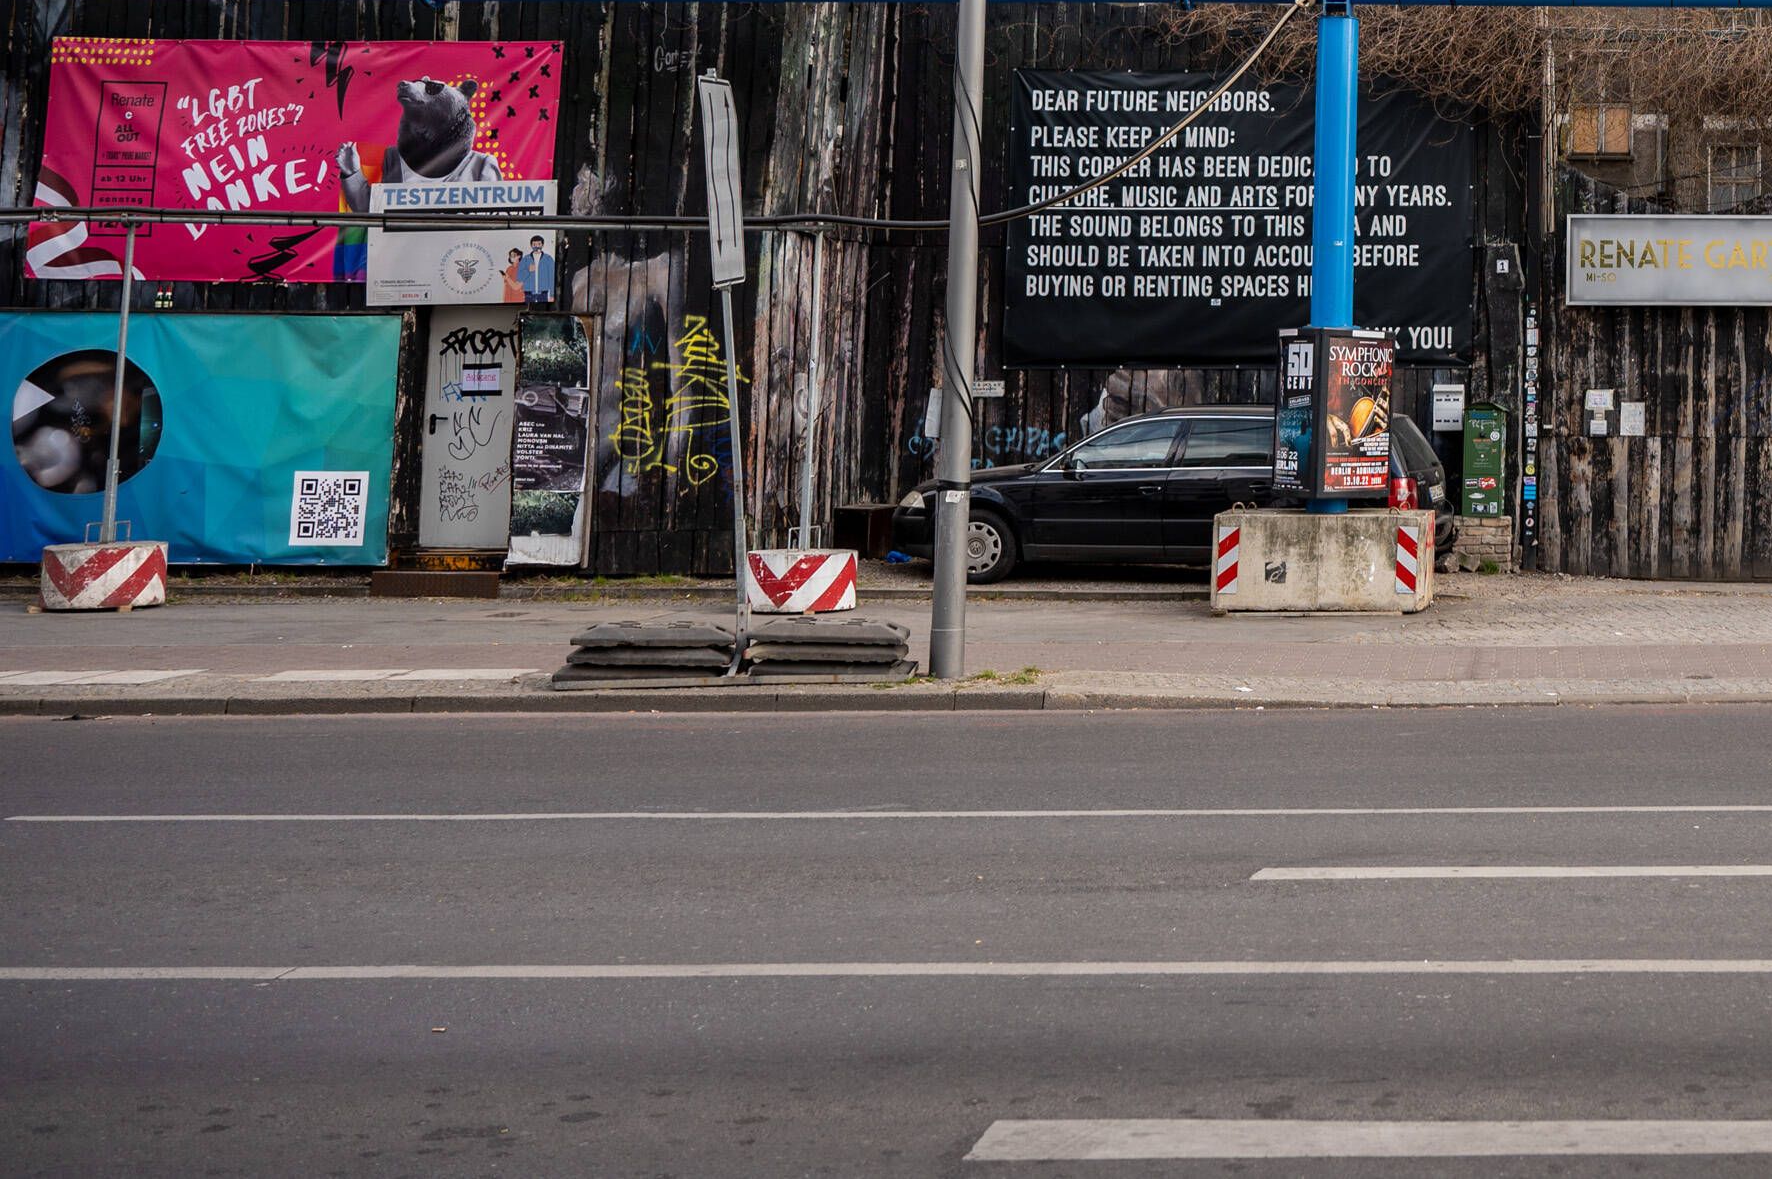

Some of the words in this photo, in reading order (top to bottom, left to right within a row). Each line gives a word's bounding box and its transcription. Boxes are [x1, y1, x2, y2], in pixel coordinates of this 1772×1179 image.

[111, 92, 155, 107] Renate
[1032, 90, 1079, 112] DEAR
[1086, 90, 1158, 112] FUTURE
[114, 123, 134, 134] ALL
[117, 132, 141, 143] OUT
[180, 118, 233, 160] FREE
[1030, 126, 1099, 148] PLEASE
[1106, 126, 1152, 148] KEEP
[1160, 126, 1178, 148] IN
[1185, 126, 1236, 148] MIND:
[182, 134, 269, 201] NEIN
[1030, 155, 1071, 178] THIS
[1078, 155, 1151, 178] CORNER
[1158, 155, 1196, 178] HAS
[1203, 155, 1250, 178] BEEN
[1367, 155, 1391, 178] TO
[115, 175, 126, 183] 12
[129, 175, 146, 183] Uhr
[99, 196, 143, 205] sonntag
[383, 185, 545, 206] TESTZENTRUM
[1122, 185, 1177, 208] MUSIC
[1185, 185, 1222, 208] AND
[1230, 185, 1278, 208] ARTS
[1386, 185, 1452, 208] YEARS.
[1028, 215, 1062, 237] THE
[1069, 215, 1132, 237] SOUND
[1140, 215, 1223, 237] BELONGS
[1231, 215, 1256, 237] TO
[1264, 215, 1305, 237] THIS
[1370, 215, 1407, 237] AND
[1027, 245, 1100, 267] SHOULD
[1107, 245, 1130, 267] BE
[1138, 245, 1195, 267] TAKEN
[1202, 245, 1246, 267] INTO
[1254, 245, 1314, 267] ACCOU
[1353, 245, 1420, 267] BEFORE
[1580, 239, 1693, 269] RENATE
[1026, 275, 1094, 297] BUYING
[1102, 275, 1126, 297] OR
[1134, 275, 1213, 297] RENTING
[1220, 275, 1290, 297] SPACES
[1408, 326, 1453, 350] YOU!
[1287, 343, 1314, 376] 50
[1328, 345, 1393, 363] SYMPHONIC
[1341, 362, 1377, 378] ROCK
[1287, 376, 1313, 390] CENT
[1289, 451, 1298, 460] 22
